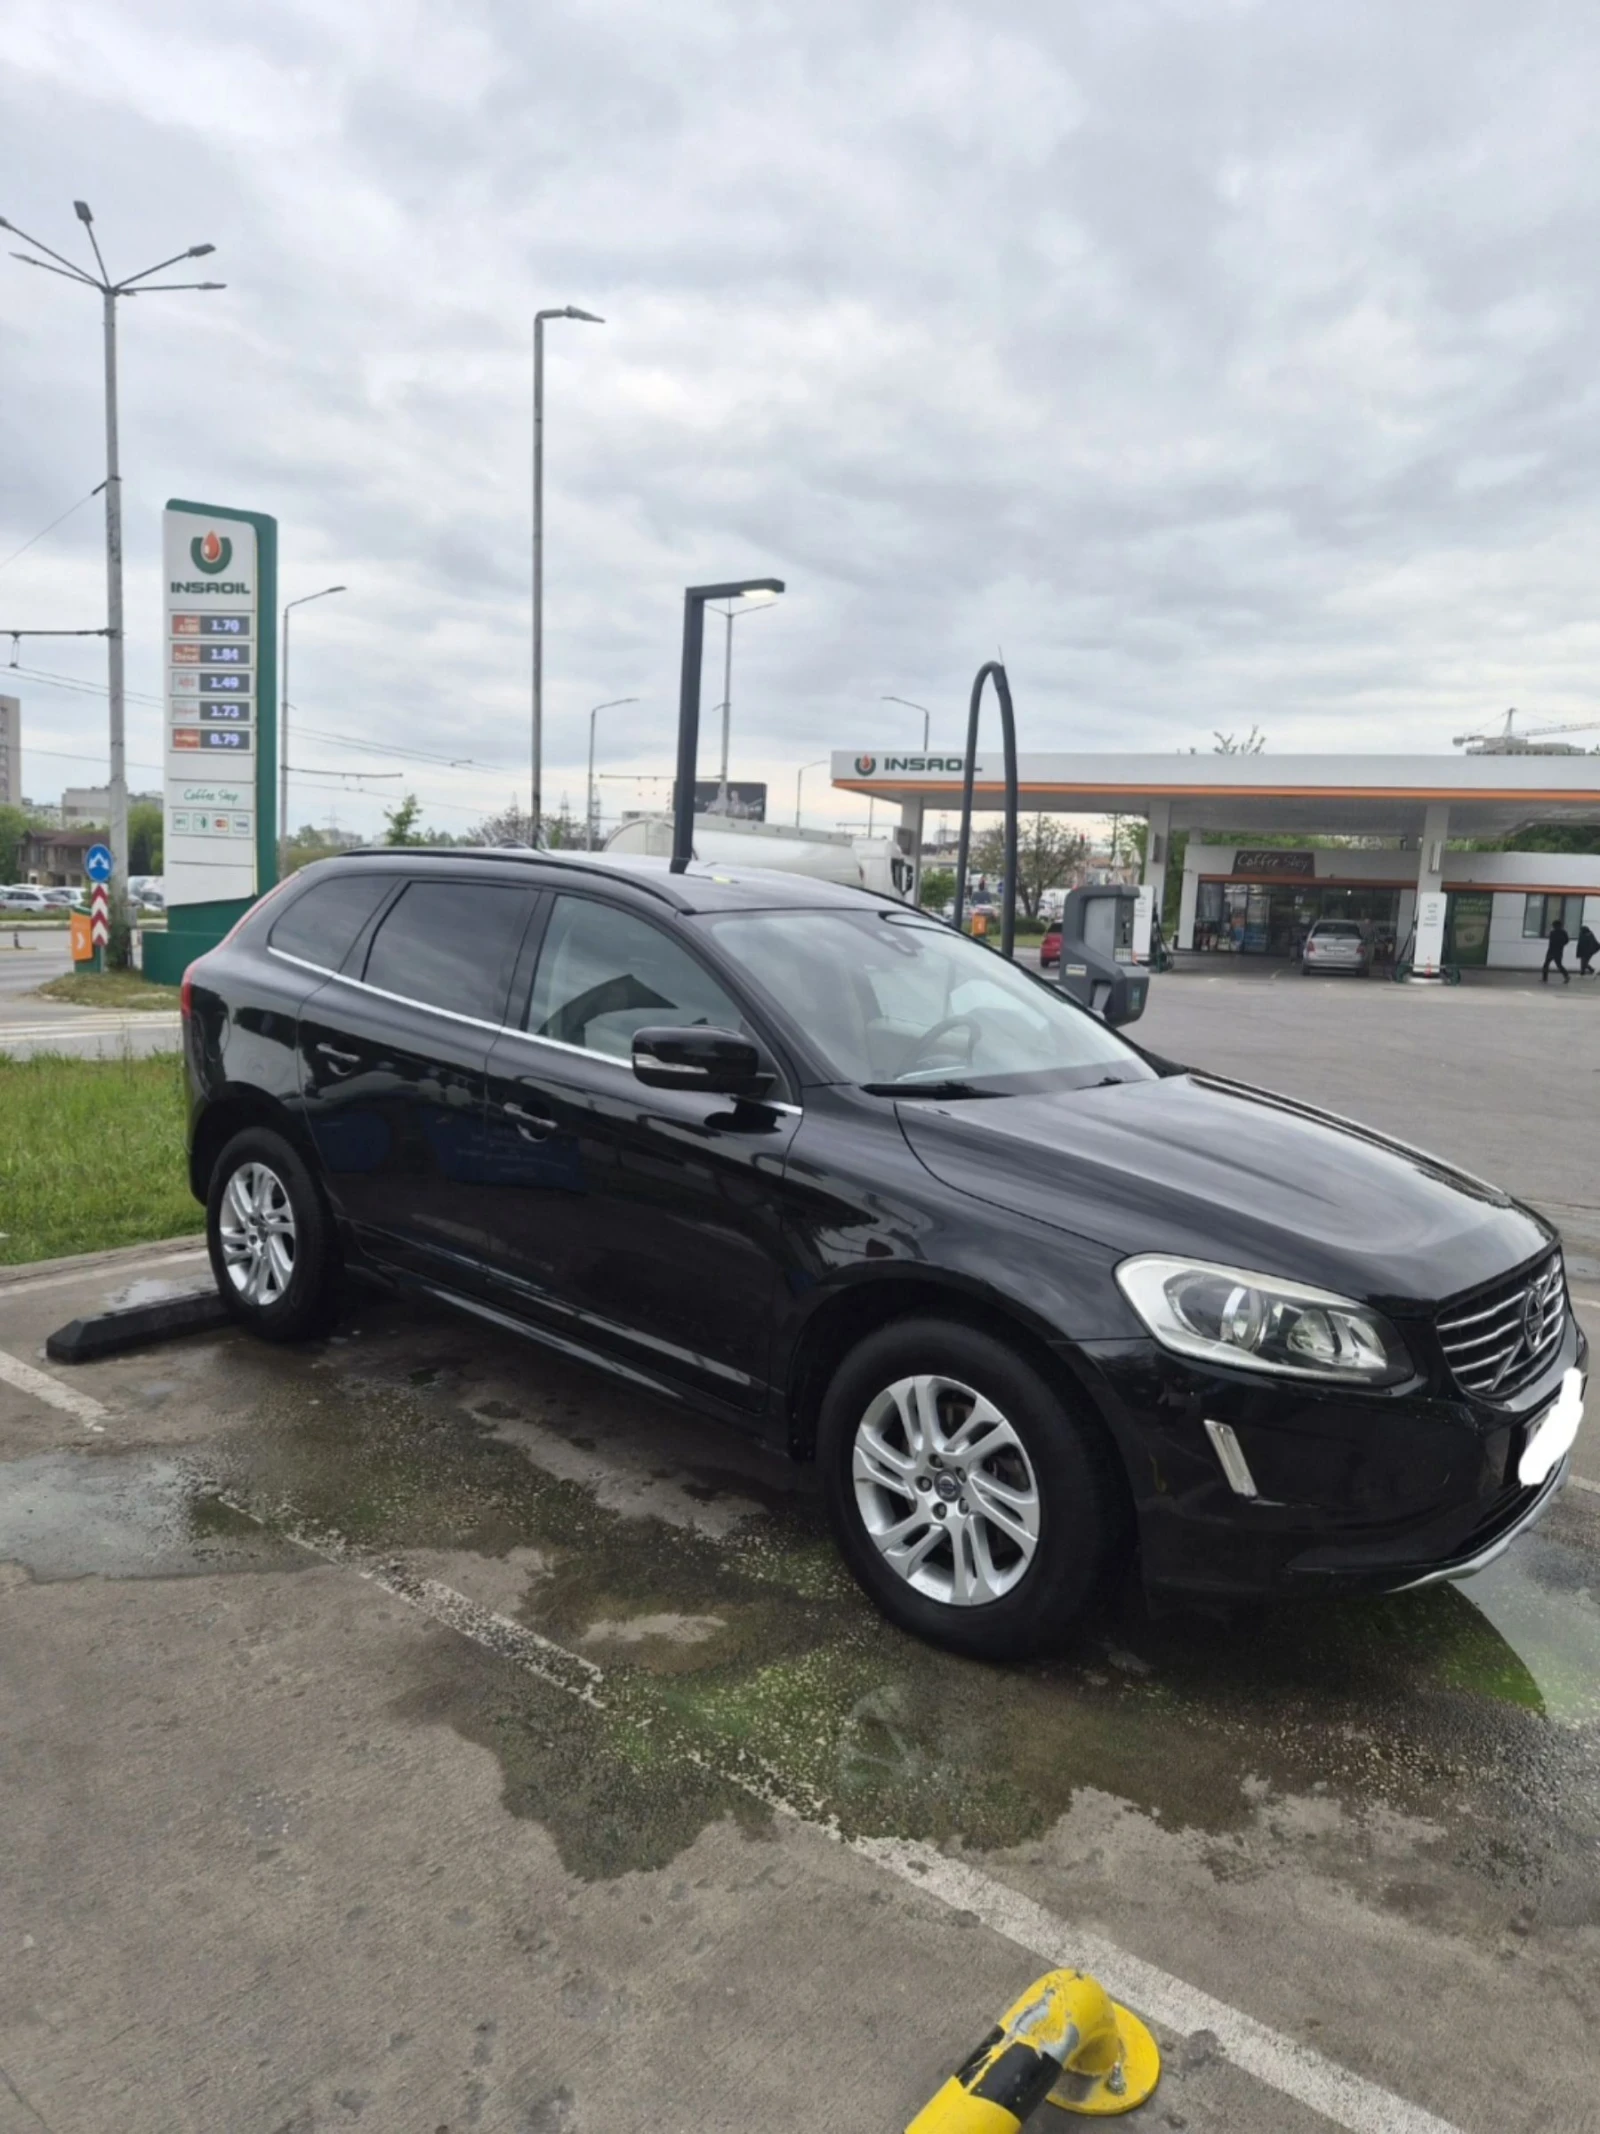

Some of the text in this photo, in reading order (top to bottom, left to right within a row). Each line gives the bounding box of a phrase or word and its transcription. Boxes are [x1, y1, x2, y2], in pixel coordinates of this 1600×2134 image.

[171, 582, 251, 595] INSAOIL
[211, 705, 239, 718] 1.73
[183, 788, 215, 801] Coffee
[1237, 852, 1279, 867] Coffee
